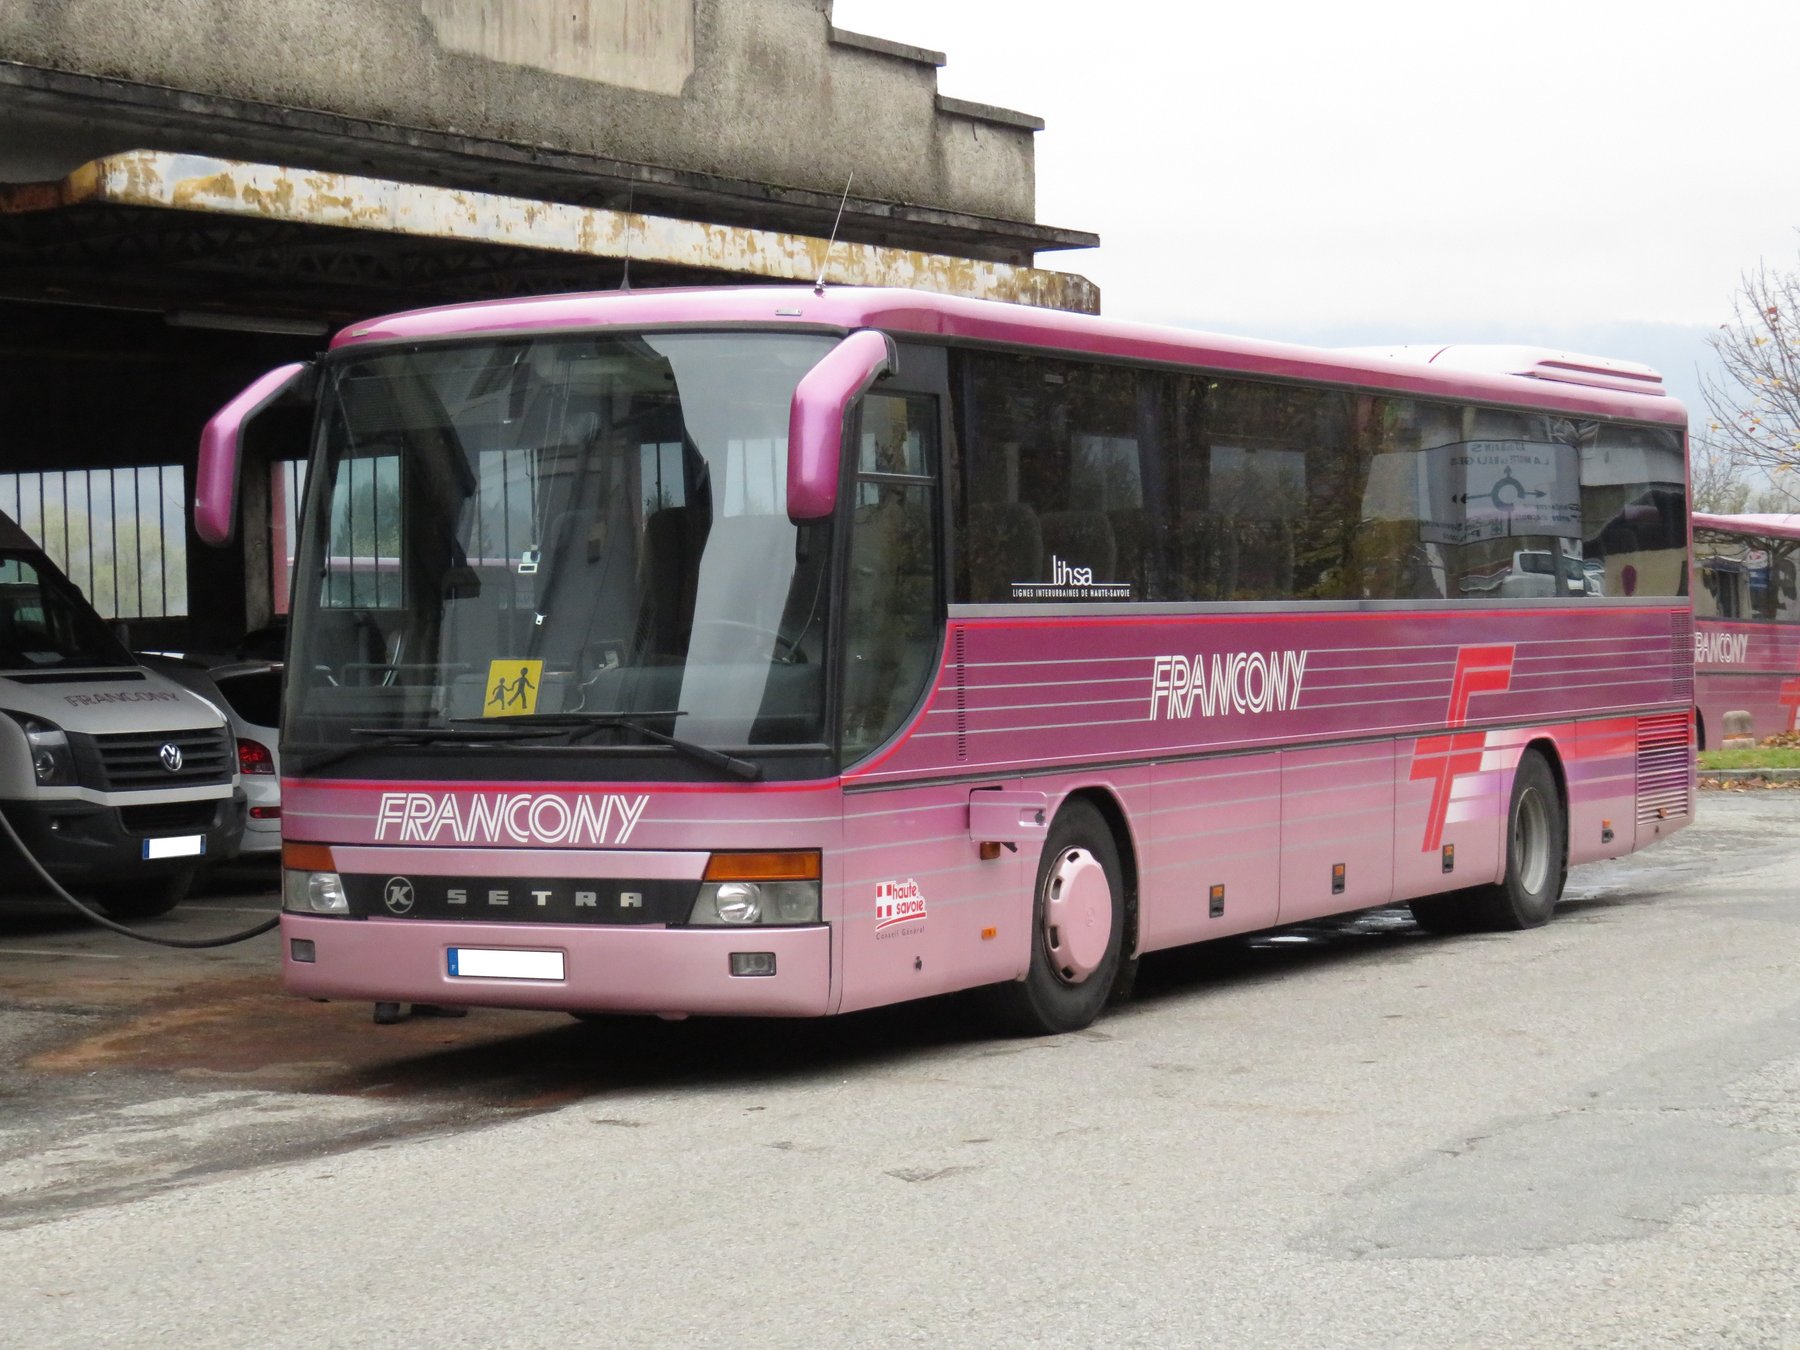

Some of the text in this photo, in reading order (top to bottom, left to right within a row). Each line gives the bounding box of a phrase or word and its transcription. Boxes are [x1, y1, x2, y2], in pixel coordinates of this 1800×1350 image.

[1052, 554, 1093, 586] lihsa
[1012, 588, 1130, 598] LIGNES INTERURBAINES DE HAUTE-SAVOIE
[1694, 631, 1748, 663] RANCONY
[1149, 649, 1308, 721] FRANCONY
[63, 691, 180, 707] FRANCONY
[374, 792, 650, 844] FRANCONY
[447, 888, 643, 908] SETRA
[892, 881, 917, 900] haute
[896, 899, 924, 915] savoie
[875, 930, 900, 940] Conseil
